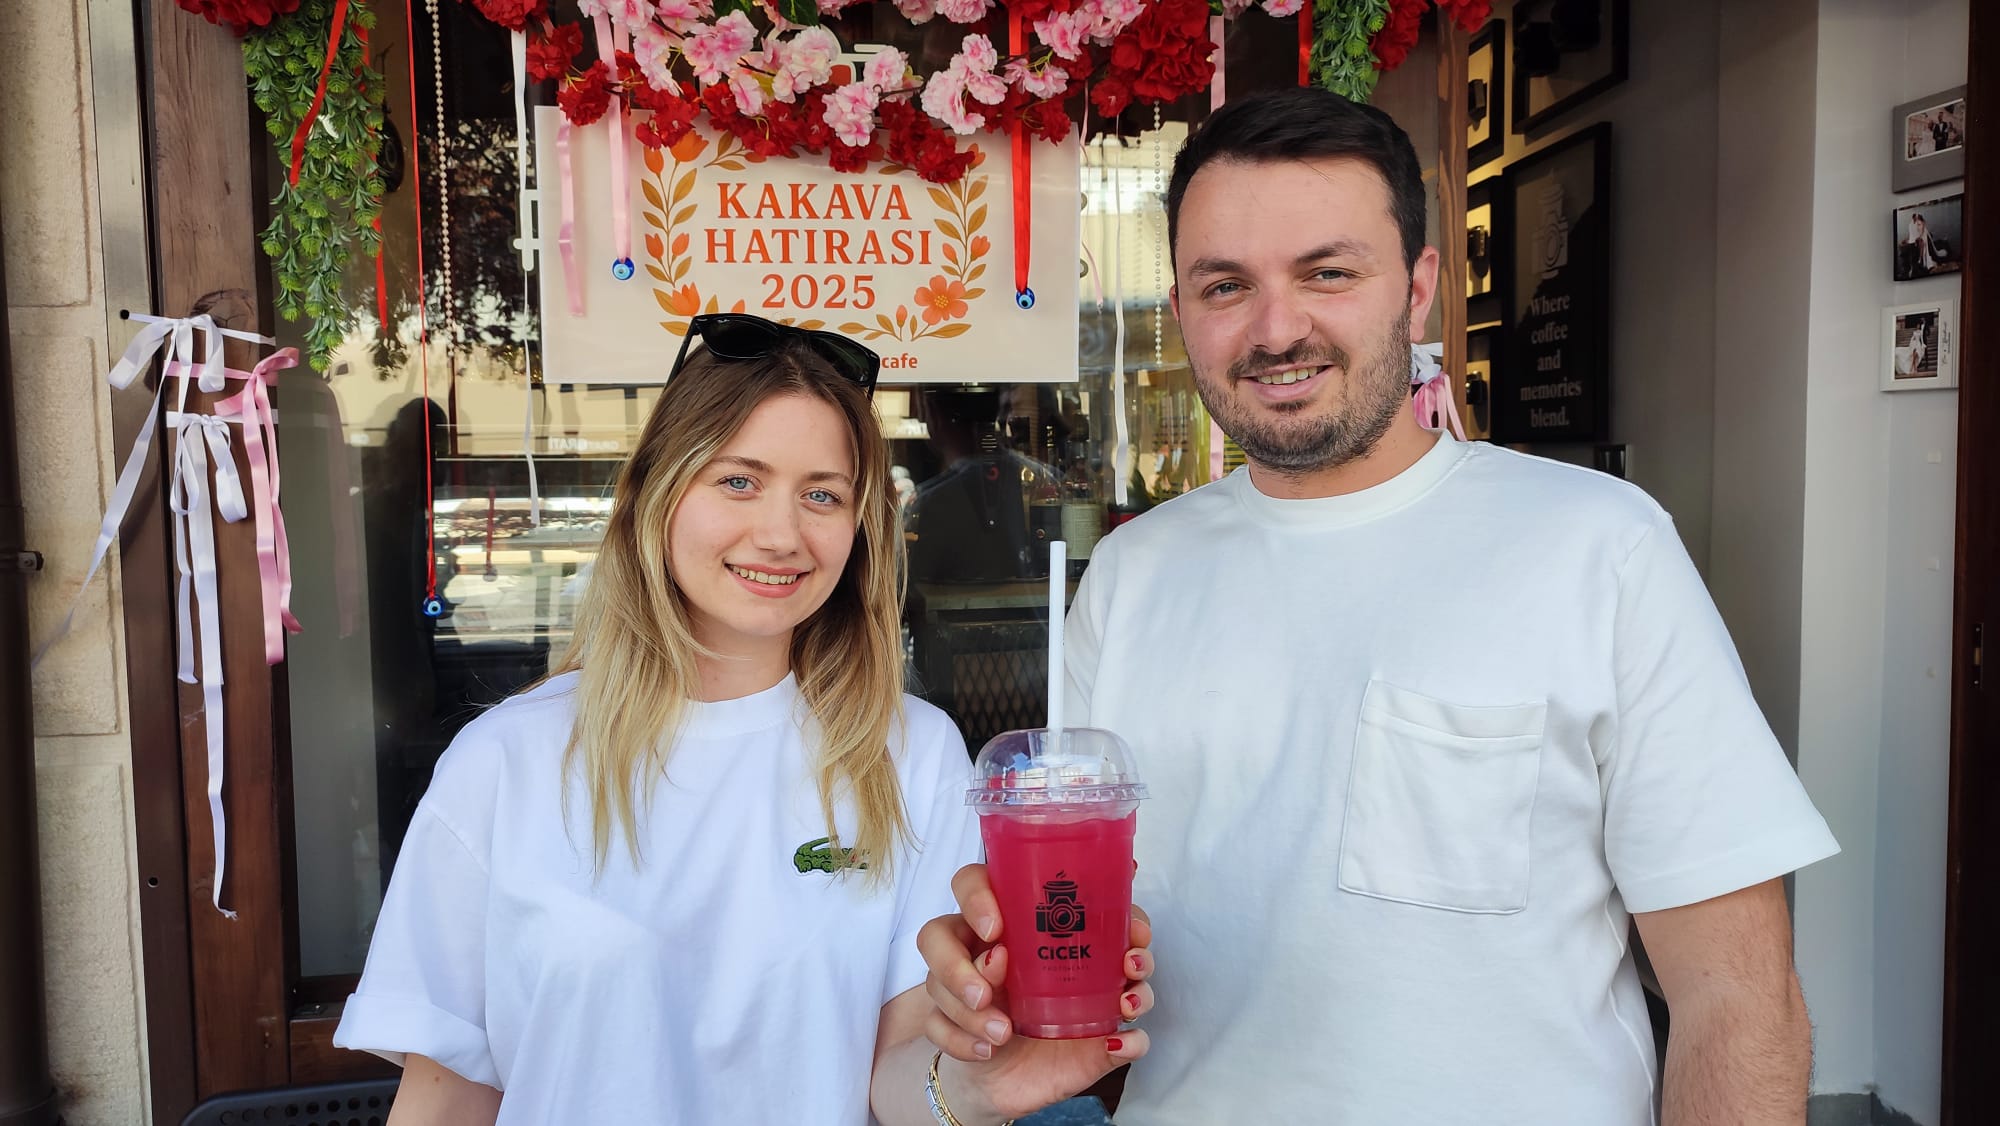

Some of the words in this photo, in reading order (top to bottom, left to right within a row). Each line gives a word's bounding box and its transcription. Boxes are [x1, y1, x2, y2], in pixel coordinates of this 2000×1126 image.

[717, 183, 912, 220] KAKAVA
[704, 229, 932, 265] HATIRASI
[762, 274, 876, 309] 2025
[1530, 294, 1570, 317] Where
[1531, 321, 1568, 344] coffee
[1537, 348, 1561, 372] and
[1520, 377, 1582, 401] memories
[1530, 406, 1570, 428] blend.
